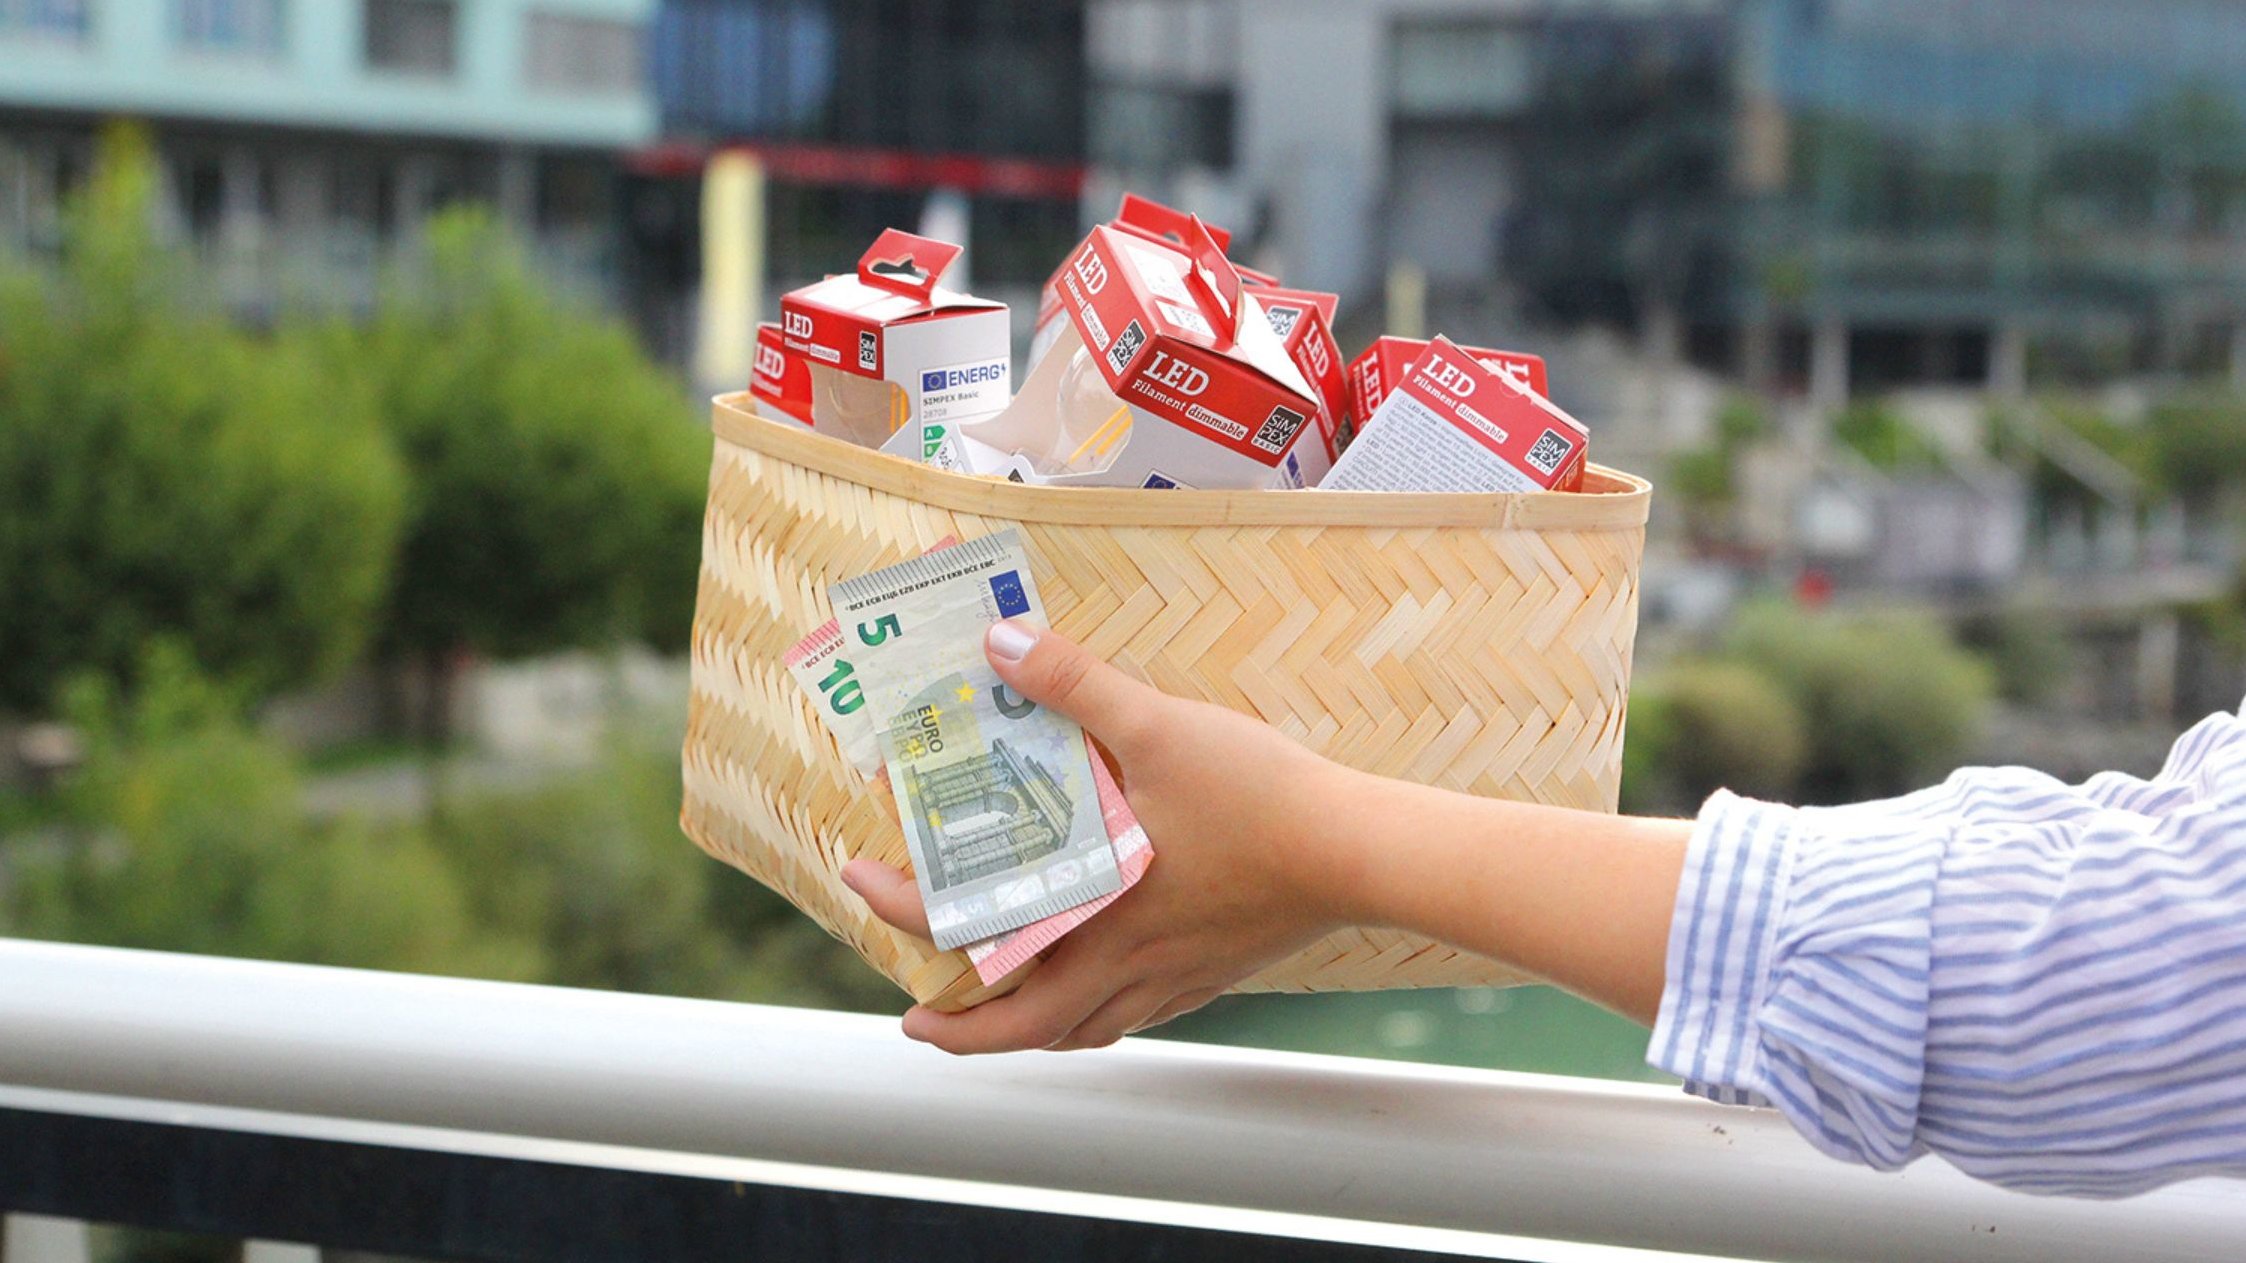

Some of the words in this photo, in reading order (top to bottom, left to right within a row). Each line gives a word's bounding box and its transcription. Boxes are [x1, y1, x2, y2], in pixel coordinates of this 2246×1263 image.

[1074, 243, 1108, 294] LED
[785, 311, 812, 339] LED
[754, 343, 785, 379] LED
[1304, 321, 1329, 377] LED
[949, 364, 1000, 387] ENERG
[1143, 351, 1209, 396] LED
[1362, 352, 1382, 415] LED
[1422, 354, 1476, 398] LED
[923, 394, 956, 406] SIMPEX
[958, 390, 979, 401] Basic
[1132, 379, 1187, 412] Filament
[1188, 404, 1245, 439] dimmable
[1413, 374, 1457, 409] Filament
[1458, 405, 1506, 442] dimmable
[925, 429, 934, 438] A
[857, 613, 902, 646] 5
[818, 659, 866, 715] 10
[917, 704, 943, 753] EURO
